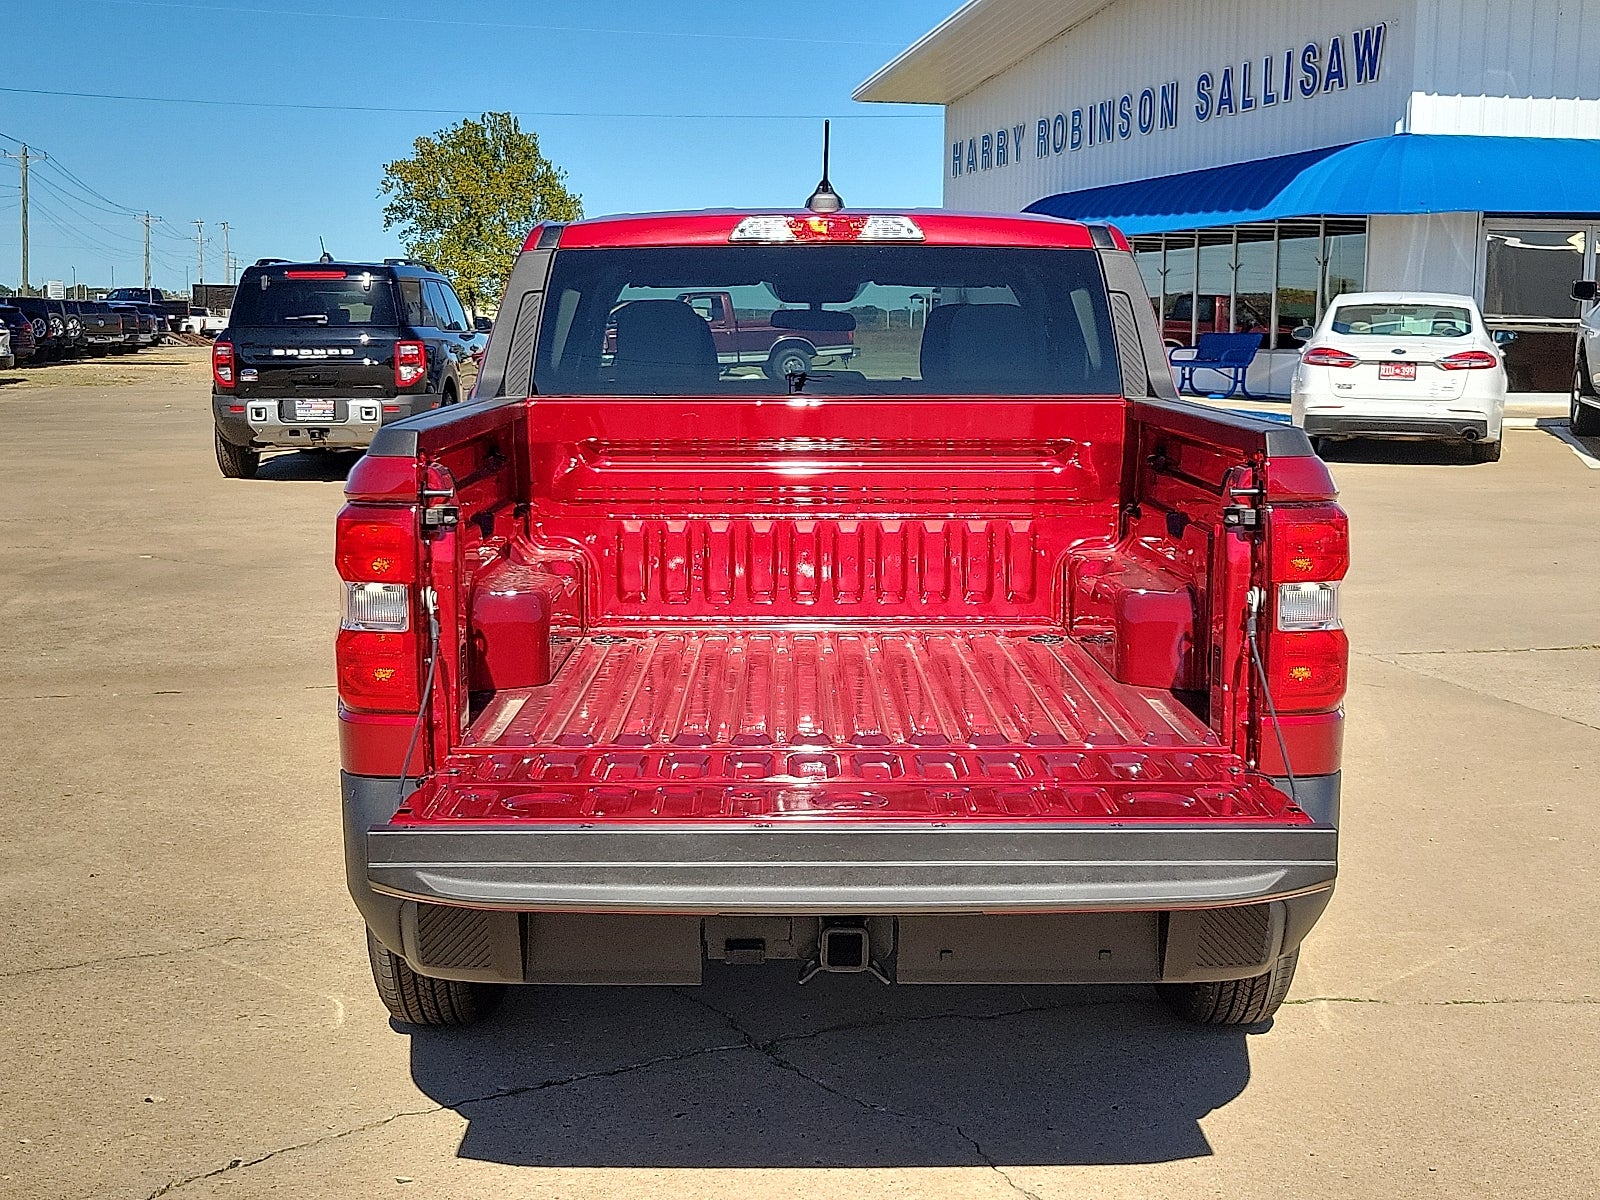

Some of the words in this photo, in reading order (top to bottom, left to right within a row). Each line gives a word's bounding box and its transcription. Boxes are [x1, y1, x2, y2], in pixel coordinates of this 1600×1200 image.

[951, 123, 1025, 178] HARRY
[1035, 81, 1178, 158] ROBINSON
[1194, 22, 1386, 122] SALLISAW
[272, 348, 354, 356] BRONCO
